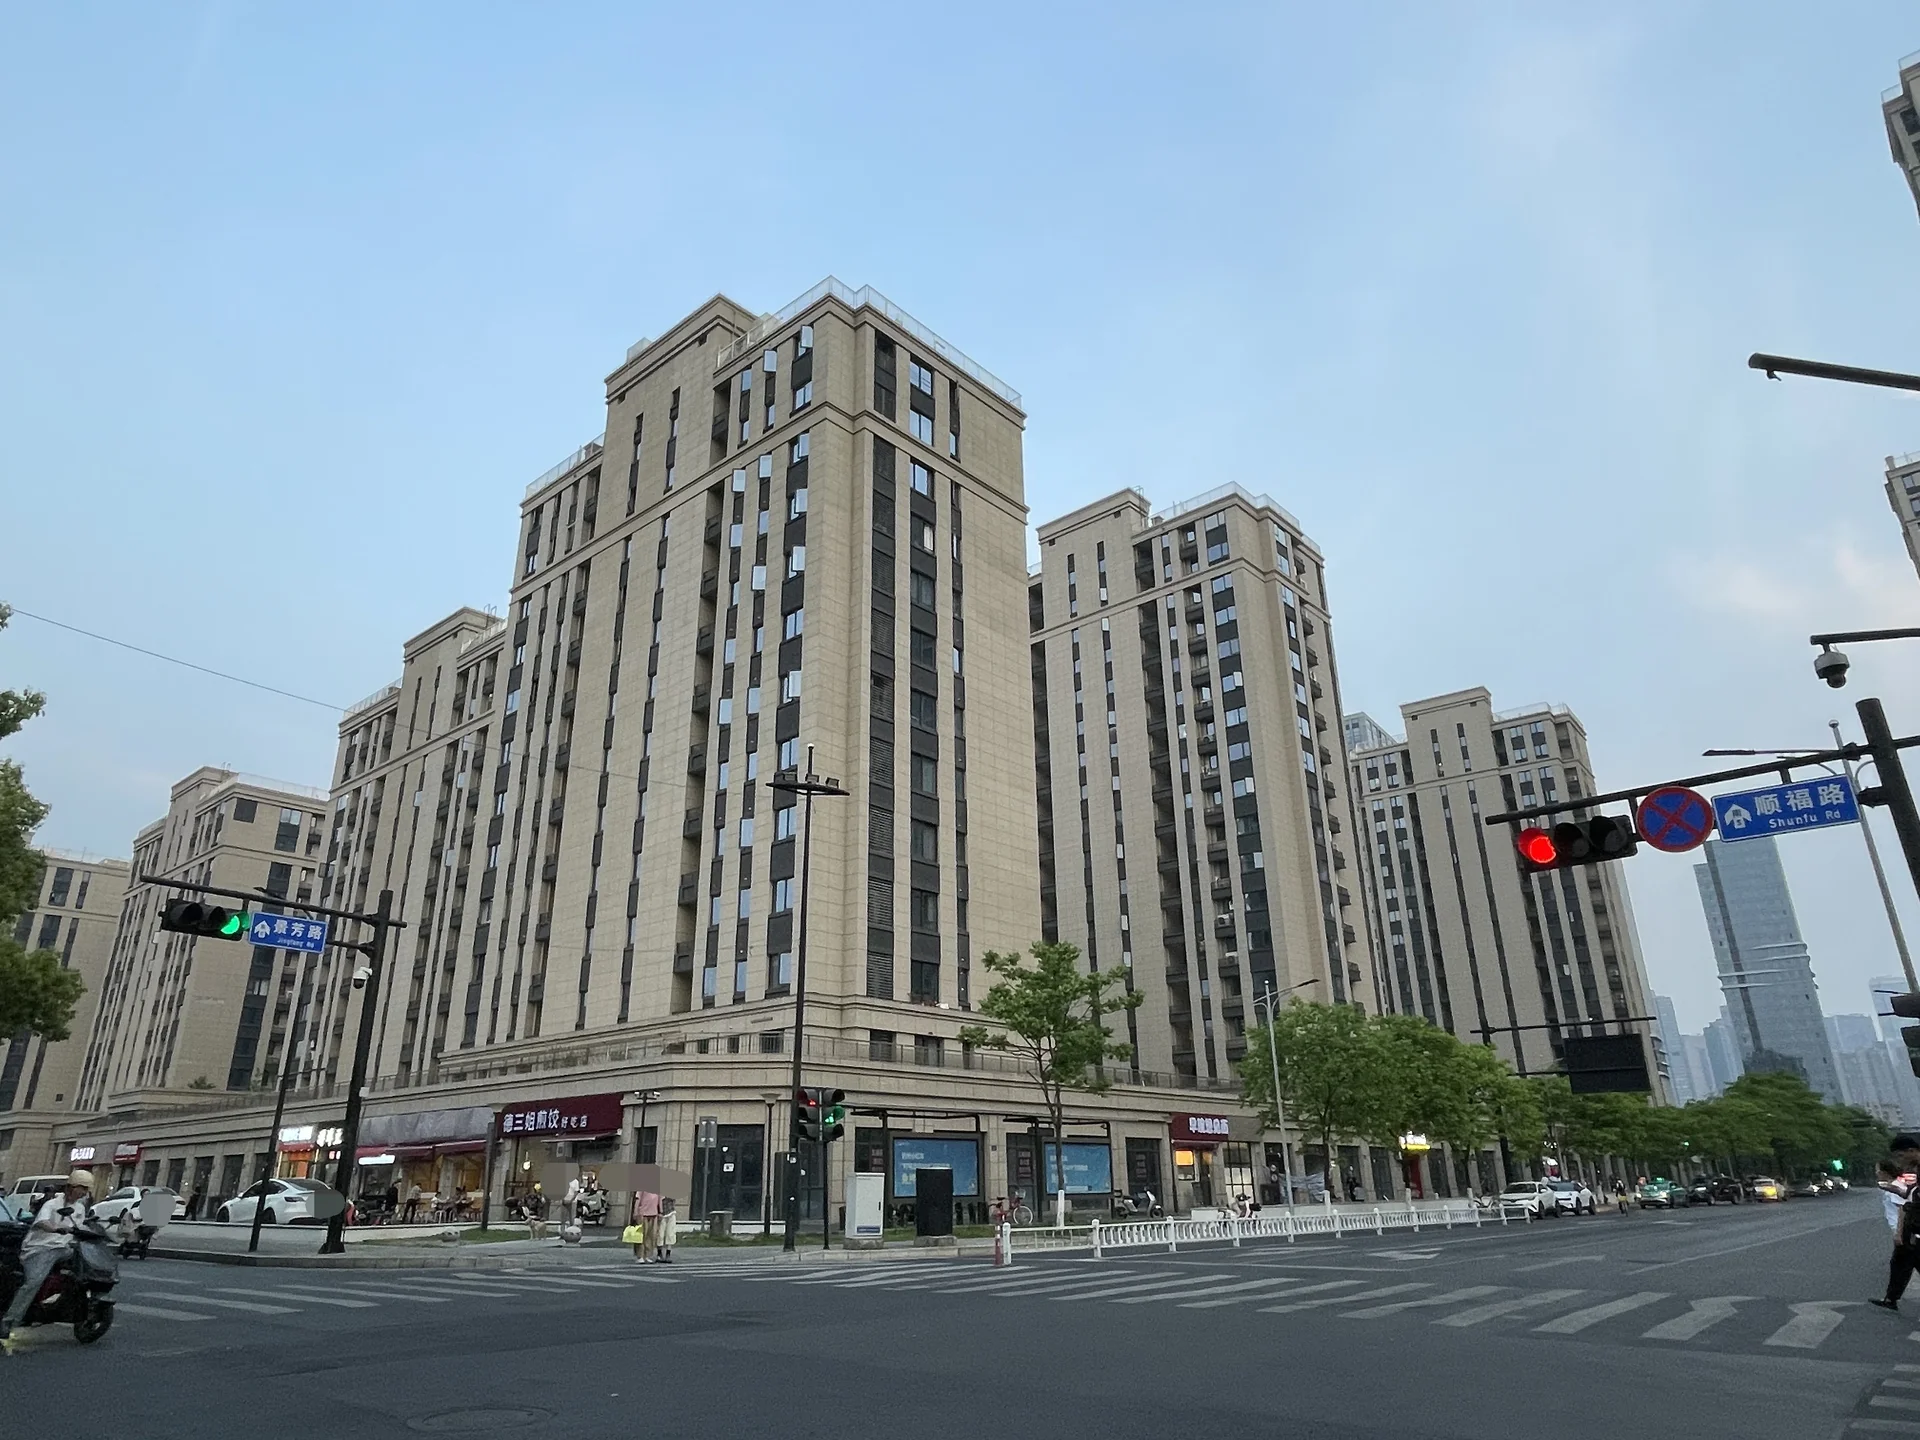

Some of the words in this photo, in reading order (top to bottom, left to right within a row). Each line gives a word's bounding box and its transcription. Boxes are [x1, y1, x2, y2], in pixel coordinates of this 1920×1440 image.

[1755, 784, 1845, 815] 顺福路
[1769, 813, 1818, 829] Shunfu
[1825, 810, 1841, 820] Rd
[273, 919, 322, 941] 景芳路
